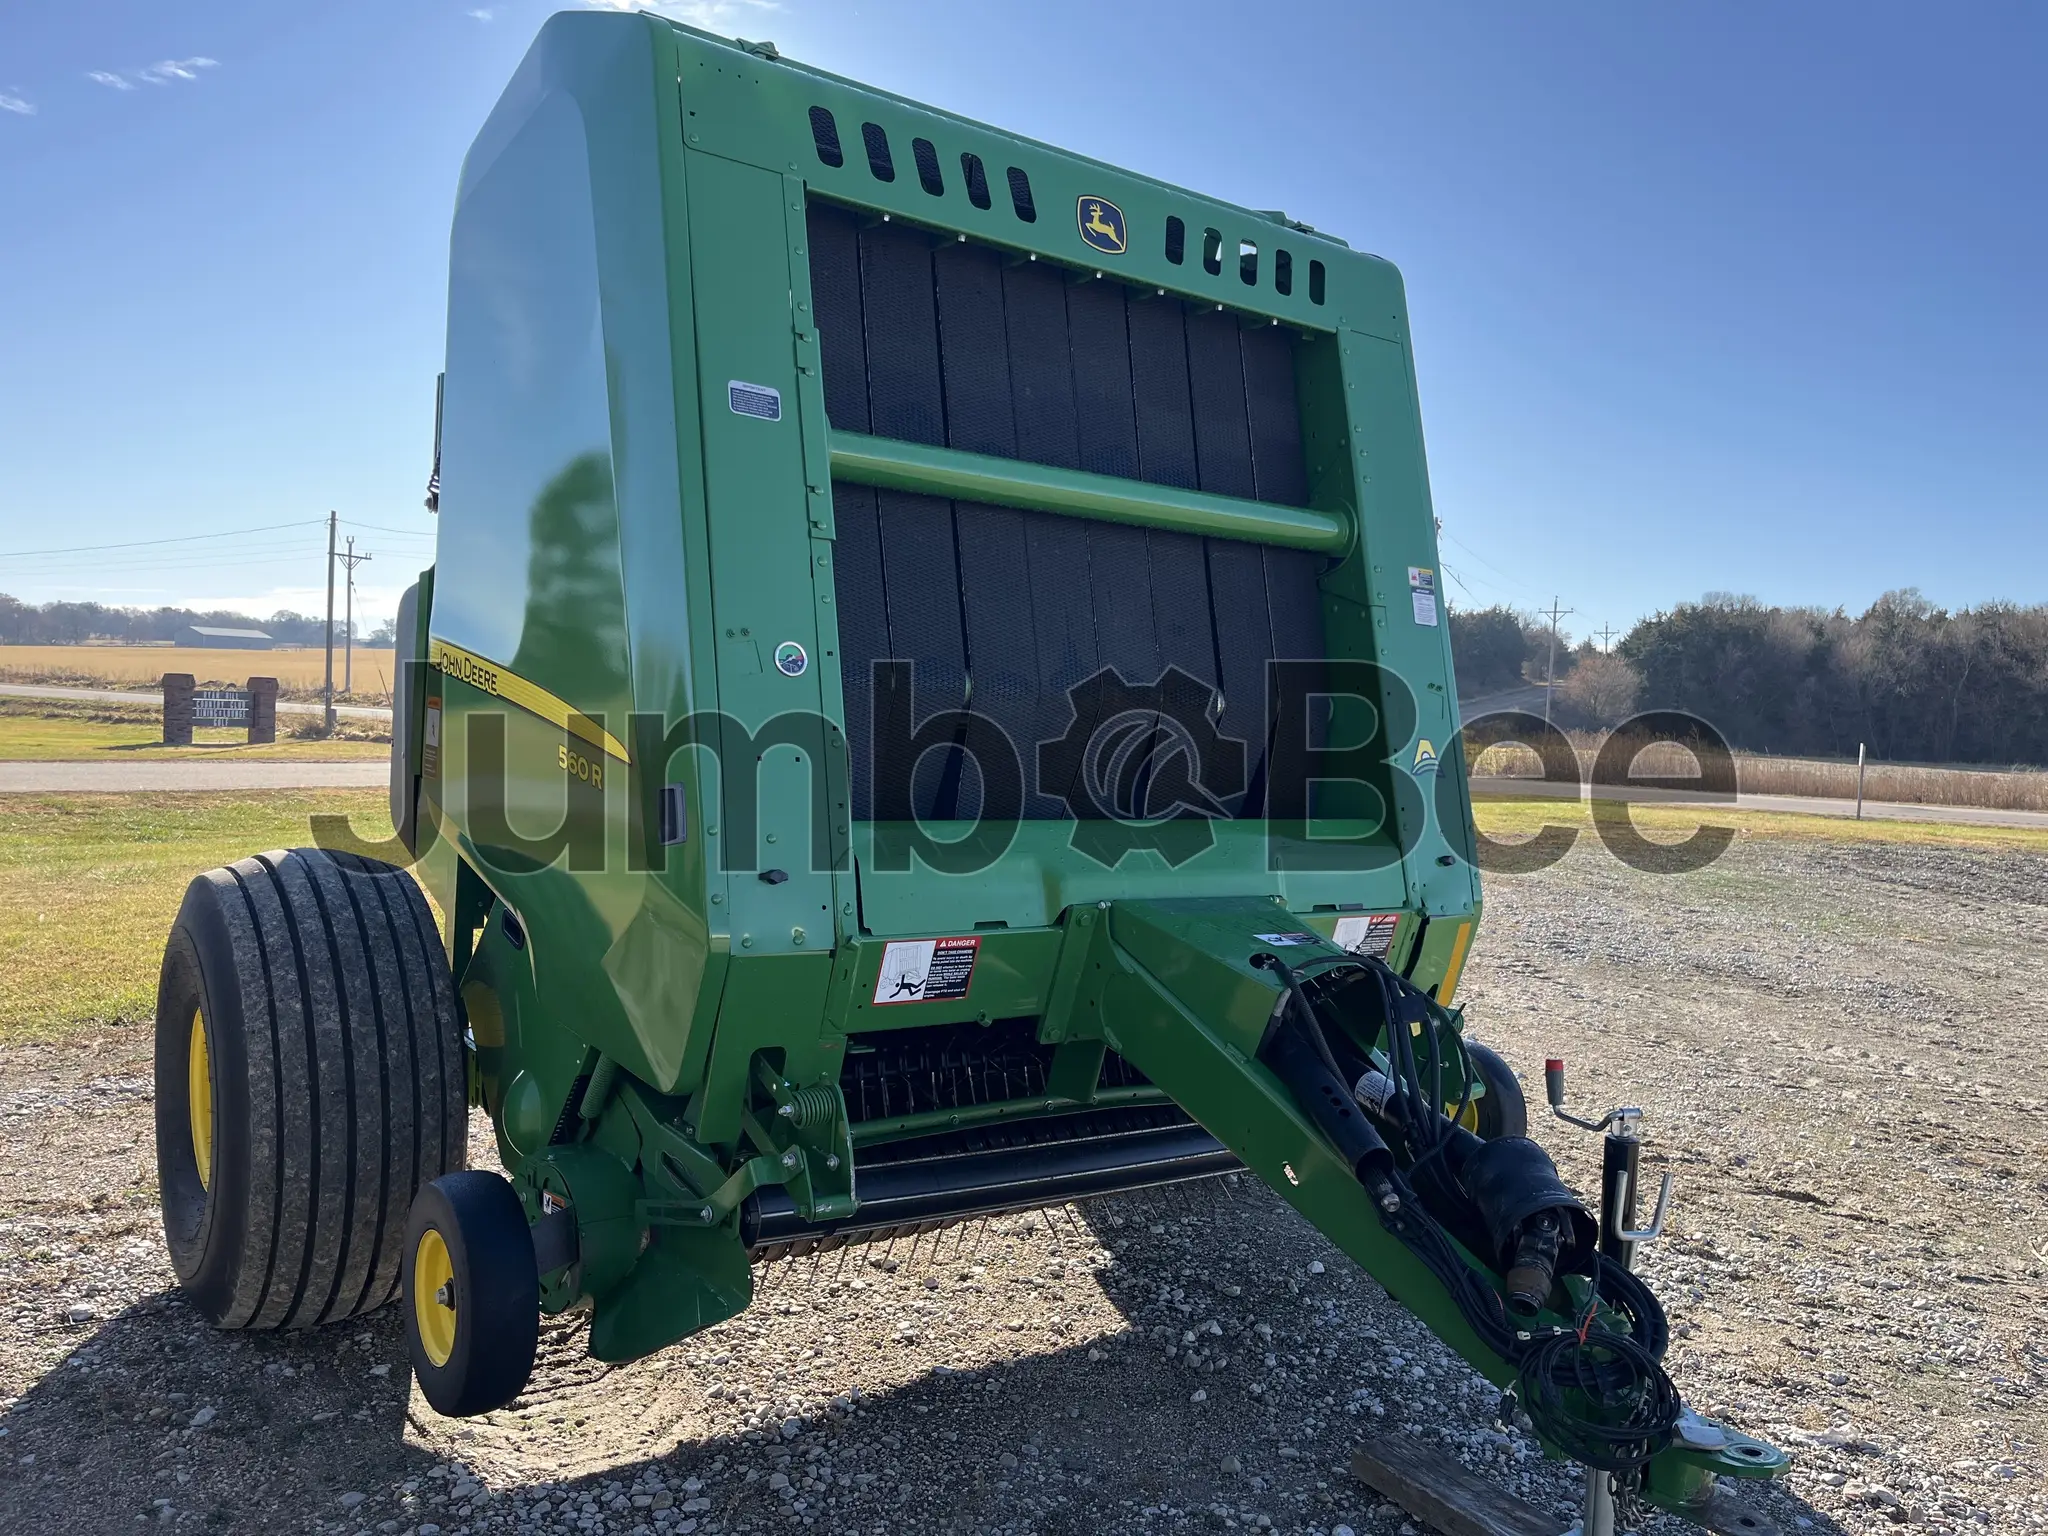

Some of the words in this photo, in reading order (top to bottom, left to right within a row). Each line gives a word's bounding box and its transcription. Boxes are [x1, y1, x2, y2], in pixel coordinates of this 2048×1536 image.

[437, 648, 462, 677] JOHN
[464, 657, 498, 693] DEERE
[196, 700, 224, 708] COUNTRY
[230, 701, 246, 709] CLUB
[558, 744, 590, 781] 560
[591, 763, 603, 791] R
[948, 939, 975, 947] DANGER
